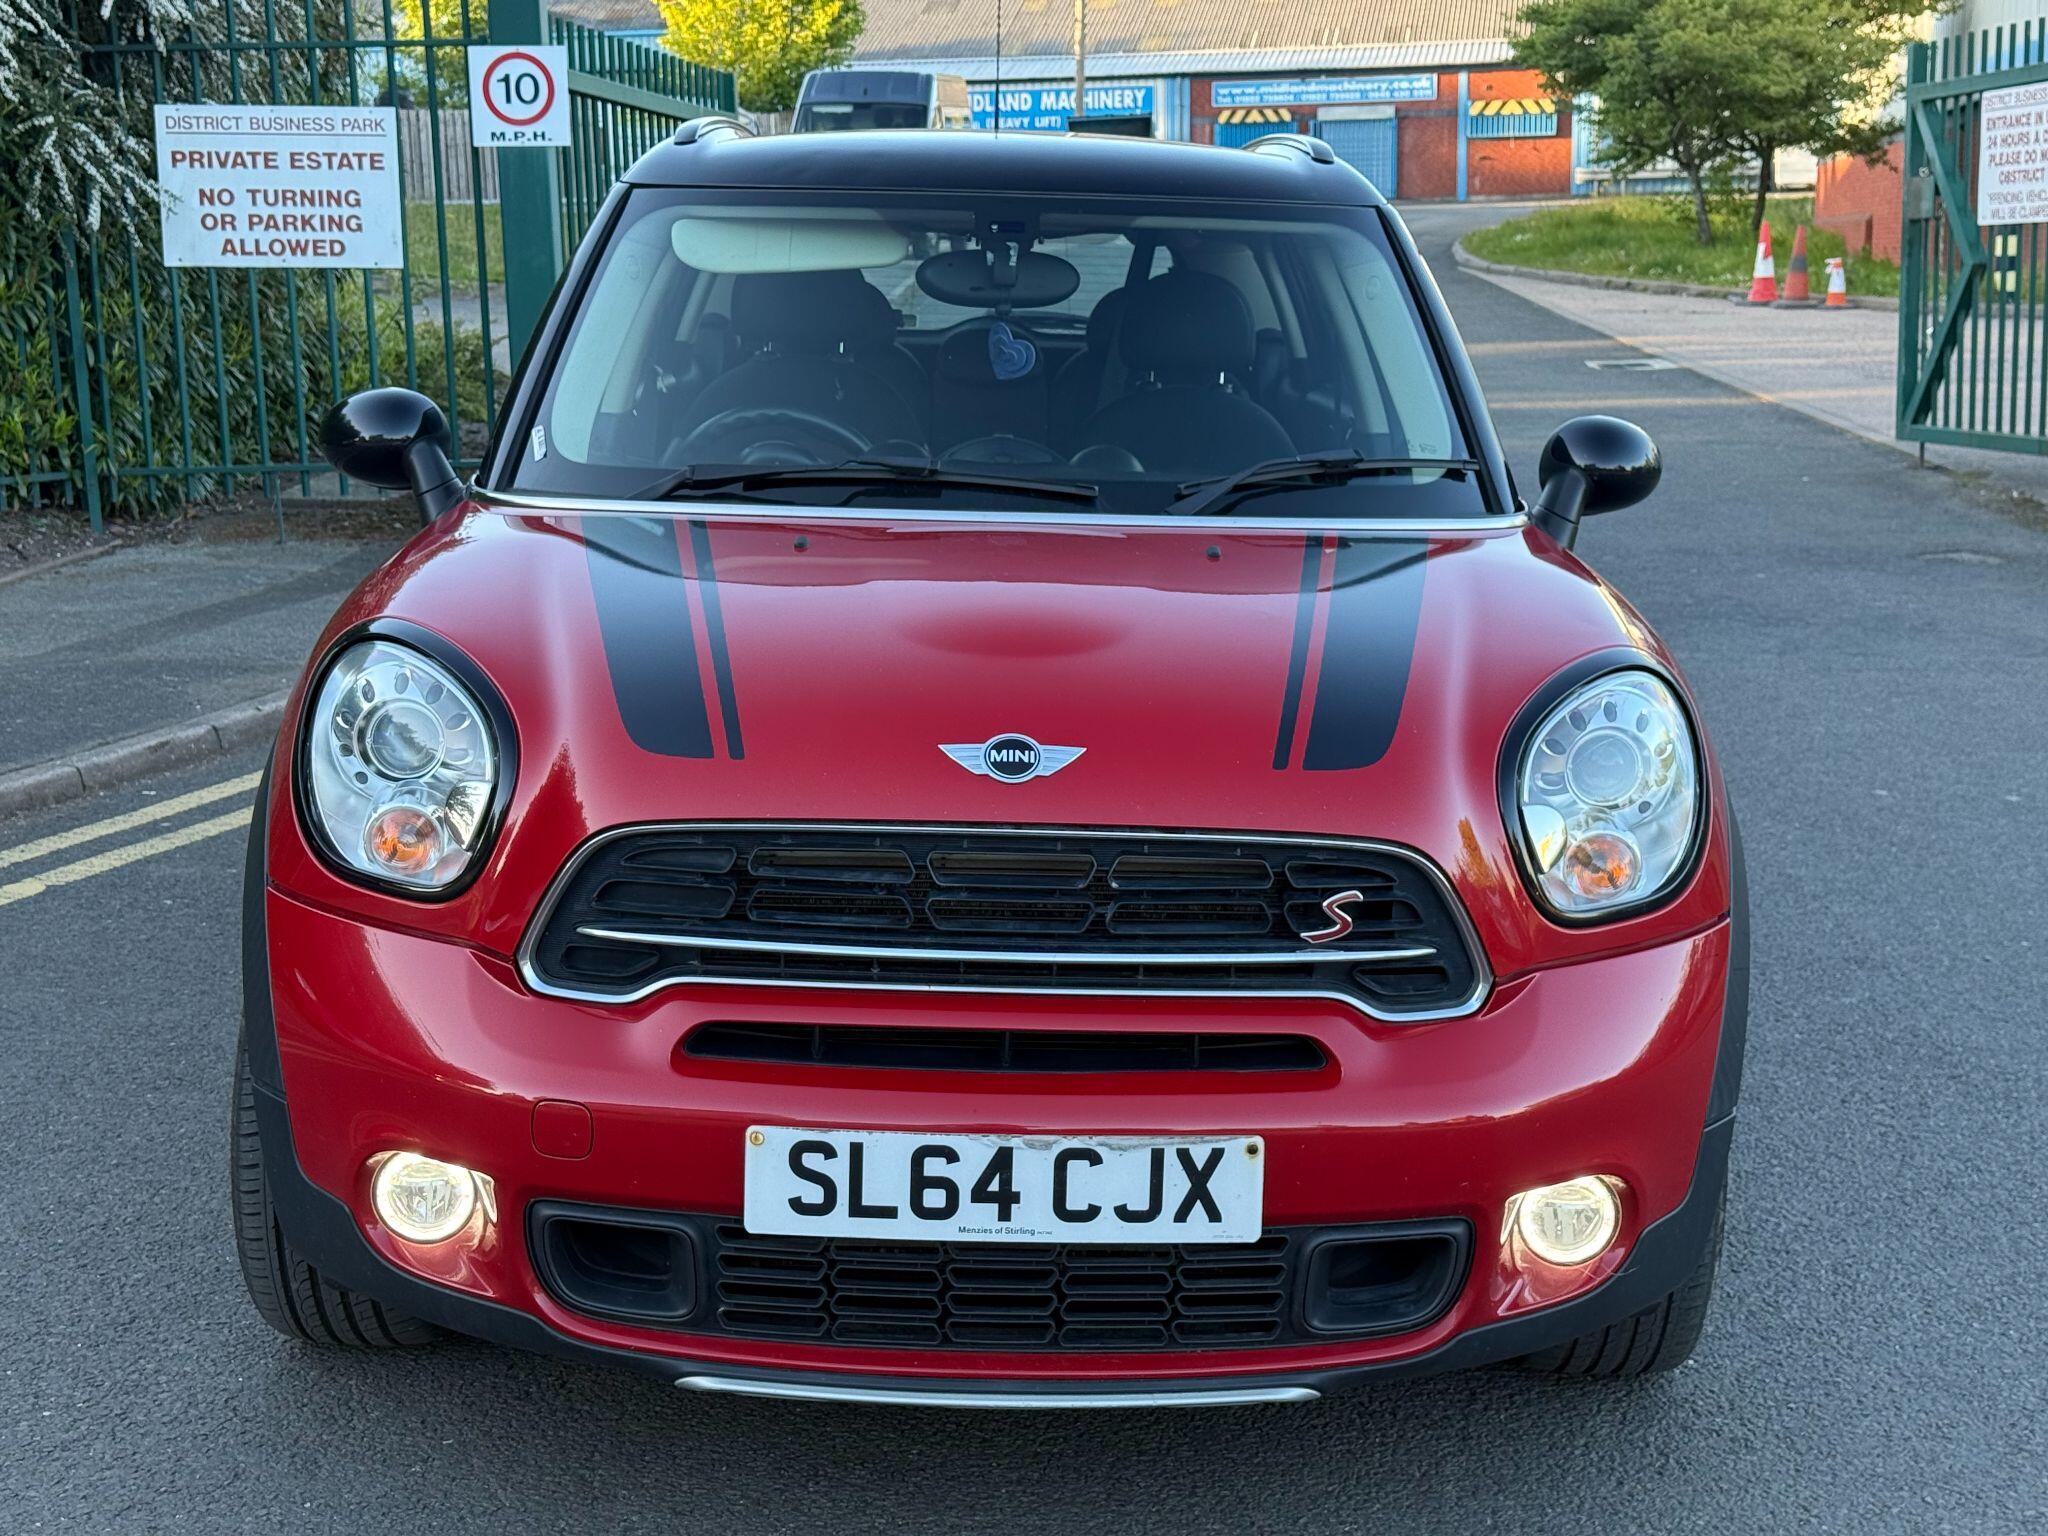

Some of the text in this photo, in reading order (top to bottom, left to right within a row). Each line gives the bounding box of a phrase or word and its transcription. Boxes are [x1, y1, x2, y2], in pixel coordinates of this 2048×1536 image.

[496, 72, 540, 105] 10
[967, 92, 1033, 113] IDLAND
[165, 115, 386, 132] DISTRICT BUSINESS PARK
[491, 131, 552, 142] M.P.H.
[171, 150, 386, 171] PRIVATE ESTATE
[198, 188, 362, 208] NO TURNING
[200, 213, 363, 232] OR PARKING
[220, 238, 346, 257] ALLOWED
[990, 749, 1035, 764] MINI
[1300, 890, 1364, 944] S
[787, 1139, 1226, 1225] SL64 CJX
[958, 1226, 993, 1235] Menzies
[994, 1226, 1003, 1235] of
[1004, 1226, 1036, 1237] Stirling
